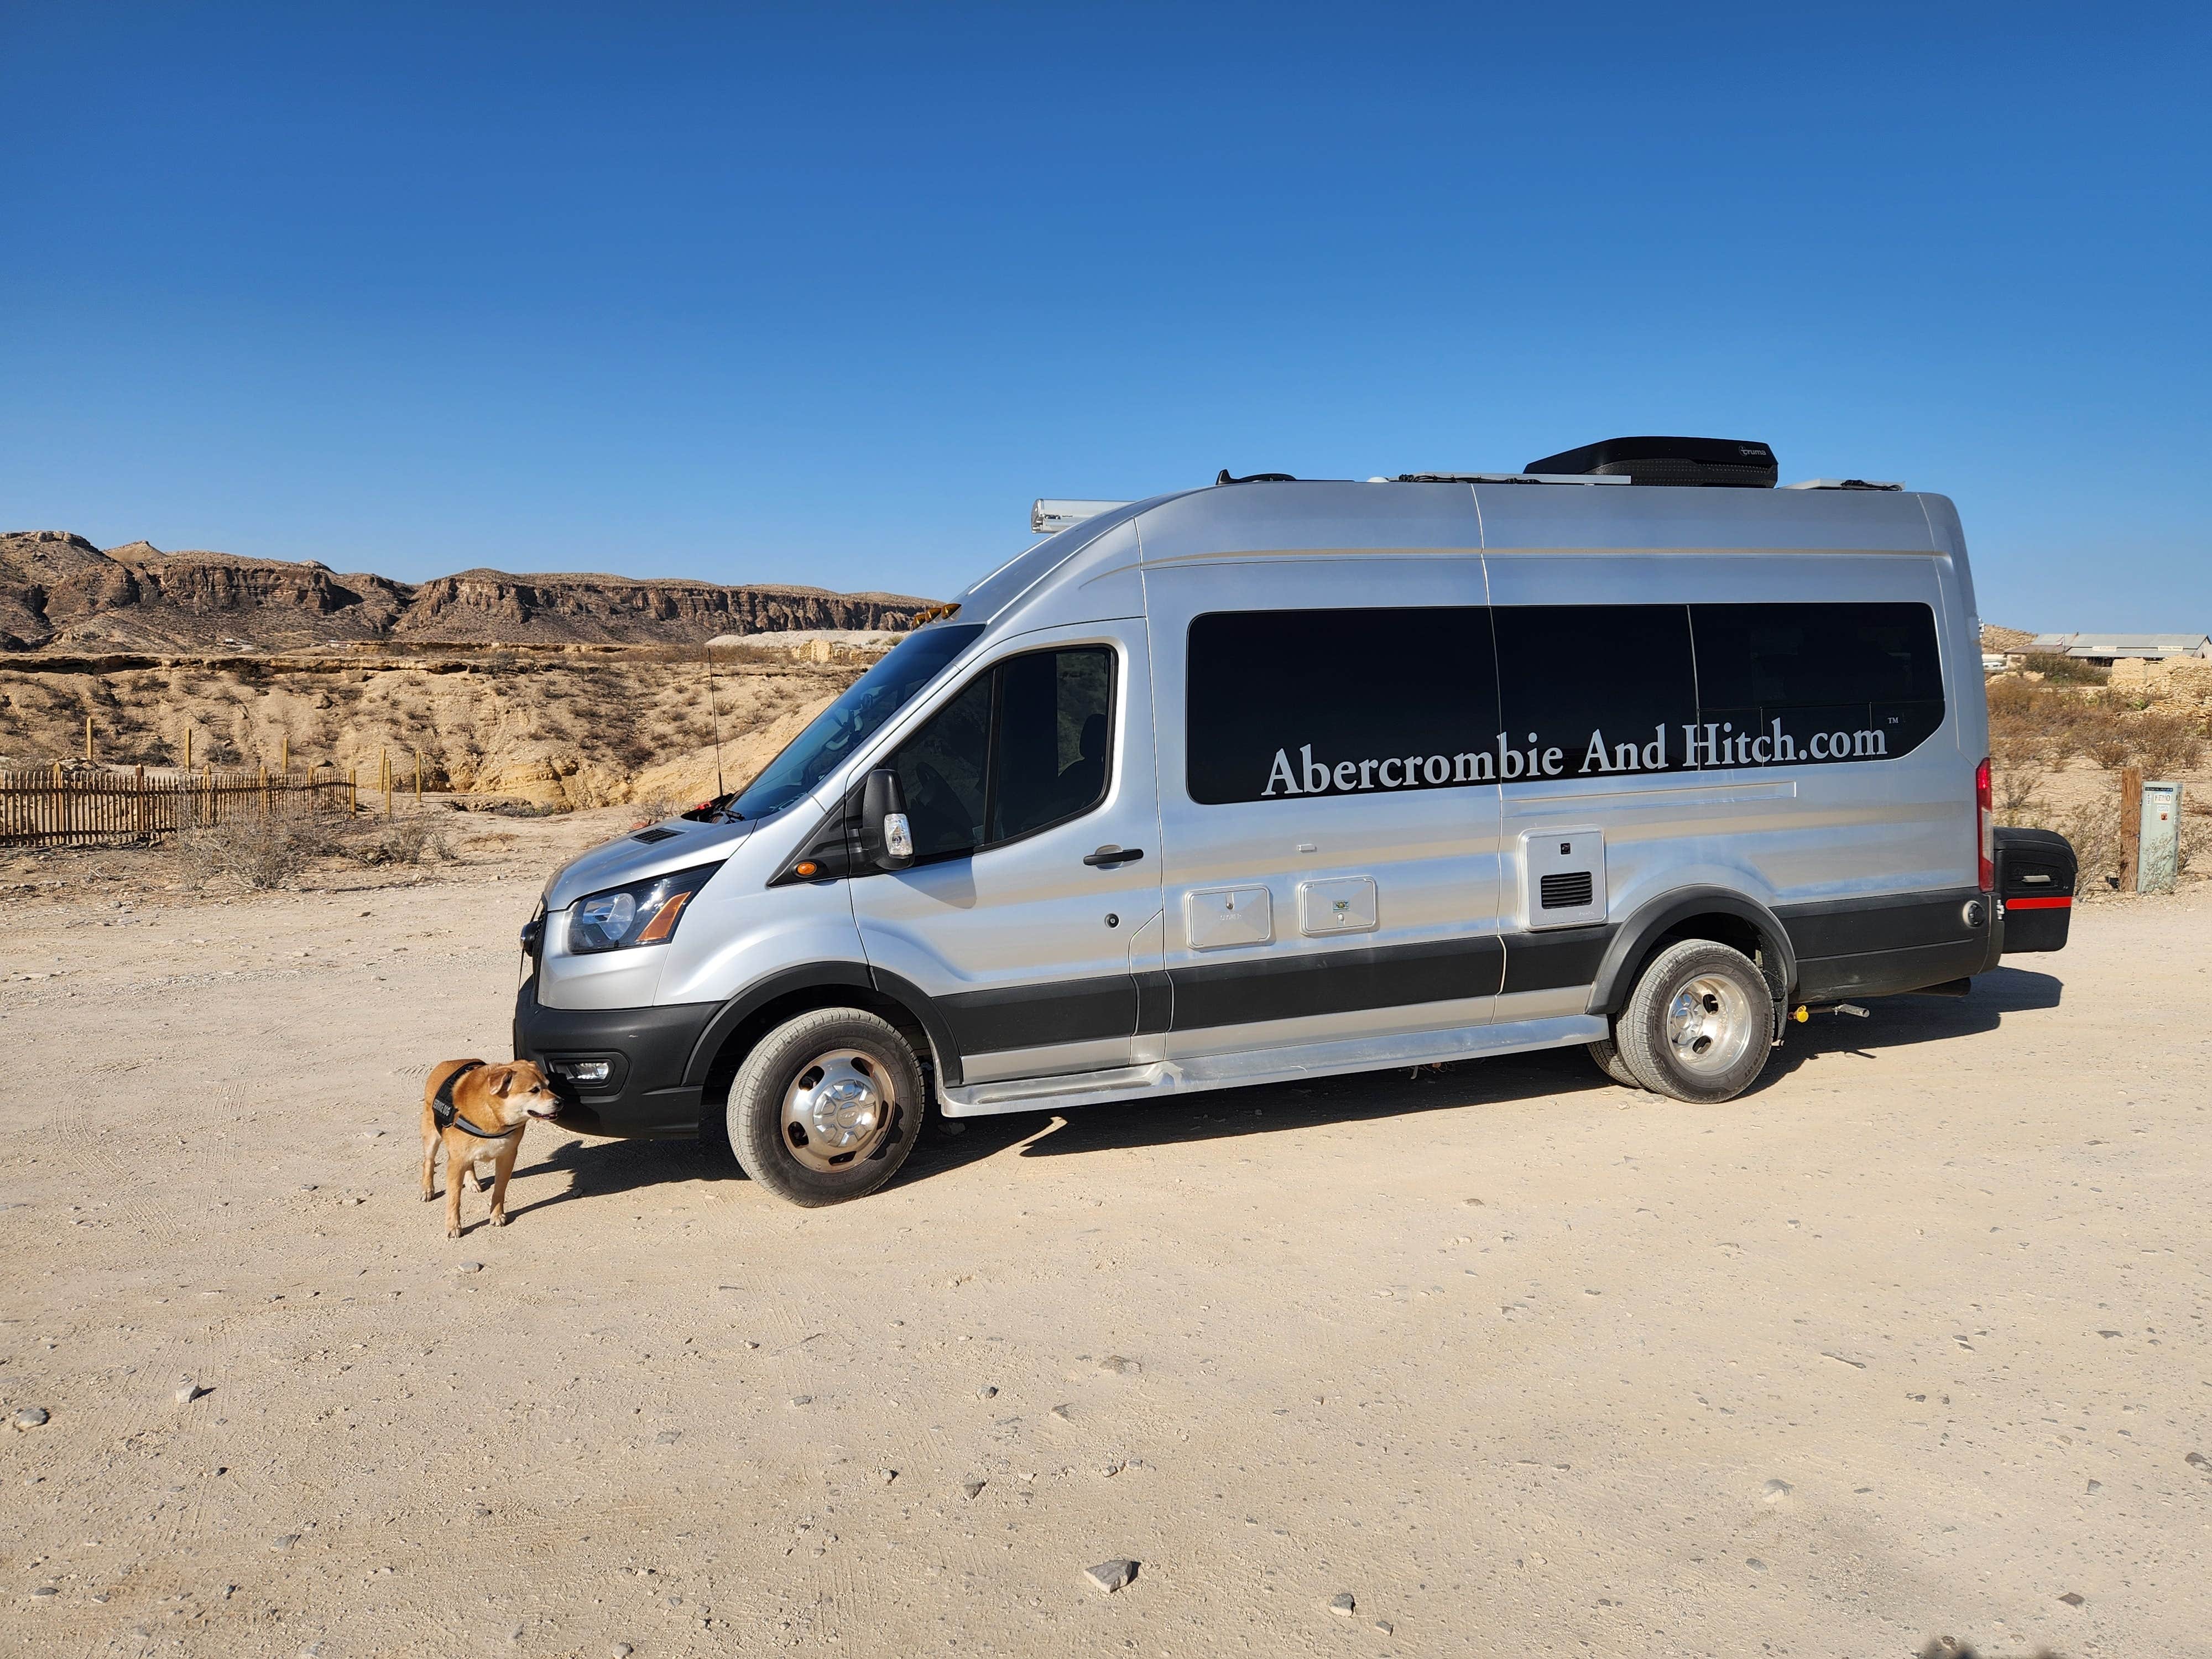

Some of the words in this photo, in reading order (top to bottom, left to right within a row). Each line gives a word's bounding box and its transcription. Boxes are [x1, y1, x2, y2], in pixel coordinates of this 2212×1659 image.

[1261, 731, 1564, 796] Abercrombie
[1578, 723, 1669, 773] And
[1682, 717, 1888, 767] Hitch.com
